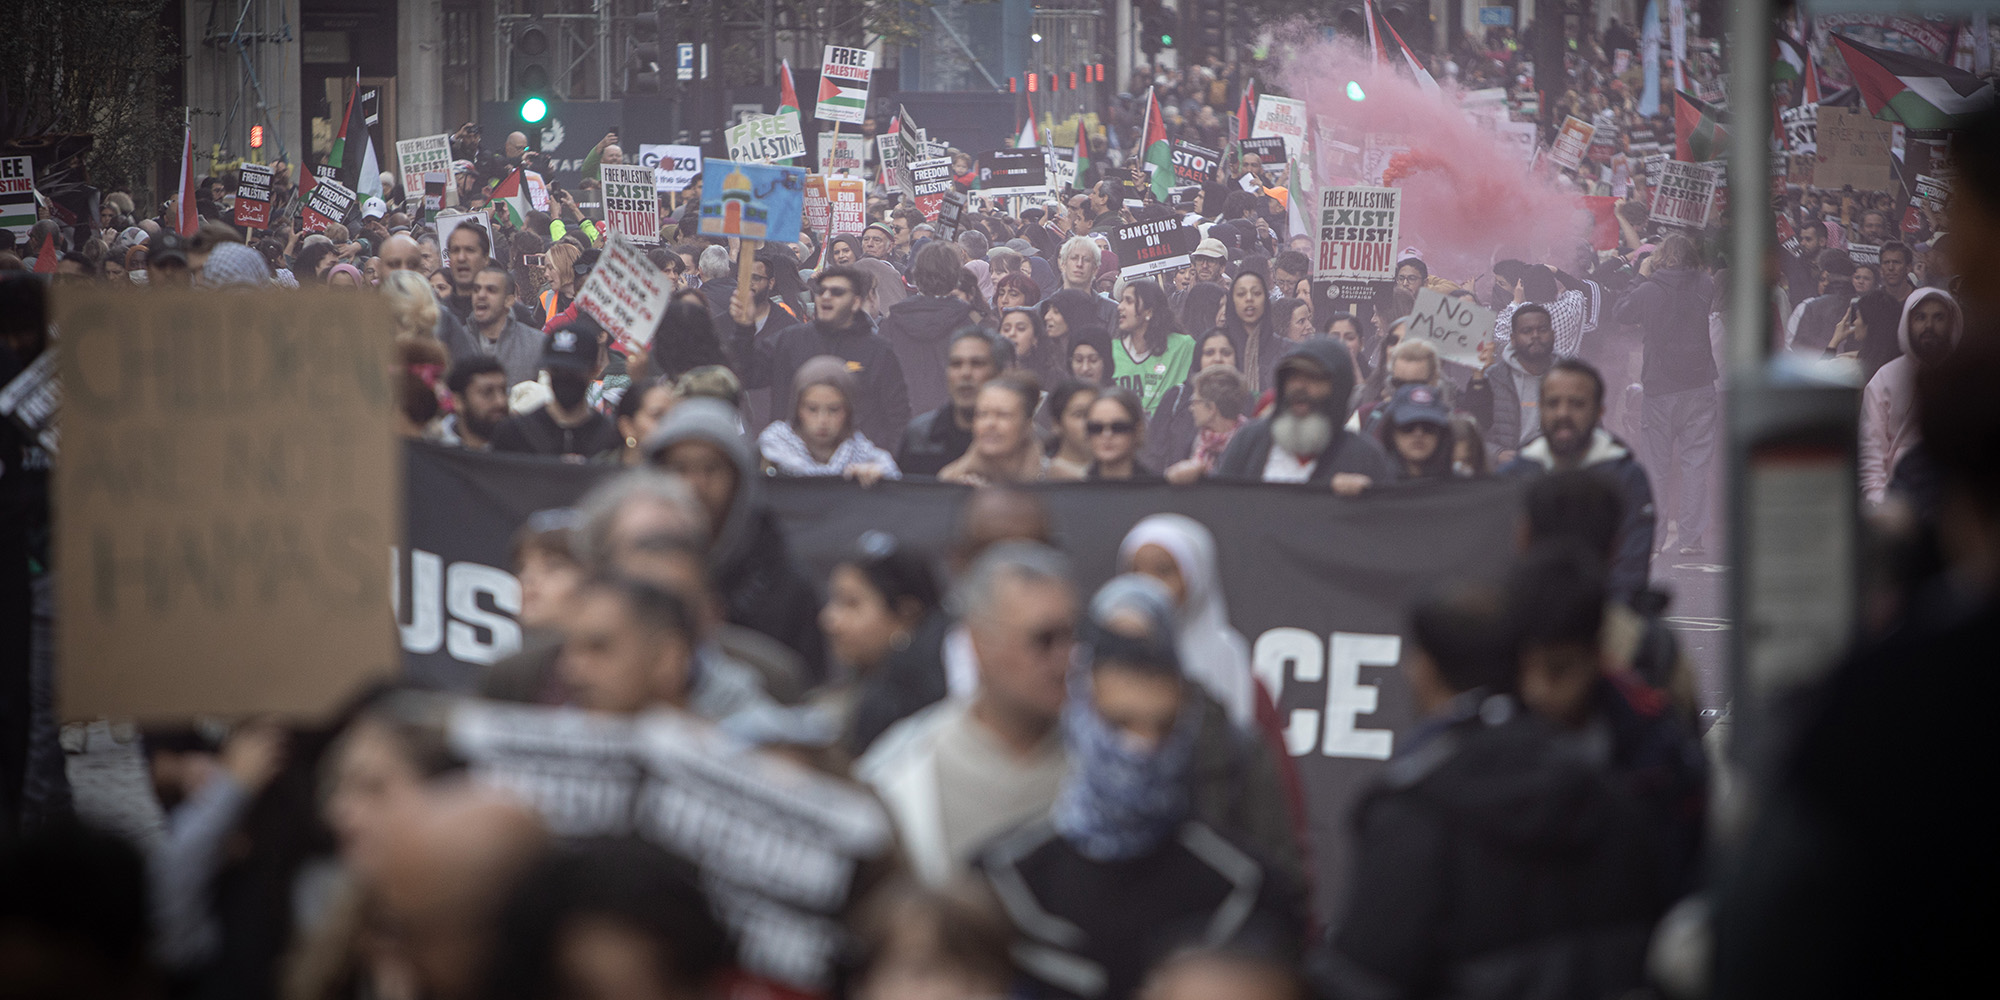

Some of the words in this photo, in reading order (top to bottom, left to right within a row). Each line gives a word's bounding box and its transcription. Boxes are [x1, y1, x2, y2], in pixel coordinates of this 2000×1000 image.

[680, 47, 693, 67] P
[831, 47, 867, 67] FREE
[824, 64, 869, 80] PALESTINE
[733, 116, 791, 145] FREE
[400, 142, 415, 154] FREE
[415, 136, 447, 152] PALESTINE
[731, 133, 805, 162] PALESTINE
[1243, 139, 1282, 149] SANCTIONS
[402, 149, 448, 165] EXIST!
[642, 152, 697, 172] Gza
[0, 158, 24, 180] EE
[317, 165, 336, 178] FREE
[404, 159, 449, 174] RESIST!
[914, 166, 949, 180] FREEDOM
[1663, 161, 1681, 174] FREE
[1681, 164, 1716, 182] PALESTINE
[242, 171, 271, 186] FREEDOM
[406, 168, 452, 192] RET!
[605, 167, 619, 183] FREE
[620, 169, 653, 185] PALESTINE
[1662, 175, 1712, 194] EXIST!
[238, 186, 271, 202] PALESTINE
[606, 184, 654, 199] EXIST!
[807, 188, 820, 197] END
[915, 180, 953, 195] PALESTINE
[1660, 186, 1709, 204] RESIST!
[318, 185, 351, 209] FREEDOM
[606, 198, 655, 212] RESIST!
[838, 192, 855, 202] END
[1323, 190, 1345, 208] FREE
[1347, 190, 1396, 209] PALESTINE
[309, 198, 344, 223] PALESTINE
[834, 212, 860, 222] STATE
[1654, 194, 1707, 224] RETURN!
[608, 210, 656, 237] RETURN!
[1322, 209, 1395, 228] EXIST!
[1119, 218, 1178, 241] SANCTIONS
[1320, 227, 1393, 242] RESIST!
[1145, 234, 1160, 247] ON
[1137, 243, 1172, 261] ISRAEL
[1319, 241, 1392, 272] RETURN!
[1850, 252, 1880, 265] FREEDOM
[1409, 312, 1468, 347] More
[390, 546, 523, 667] US
[1253, 627, 1402, 761] CE
